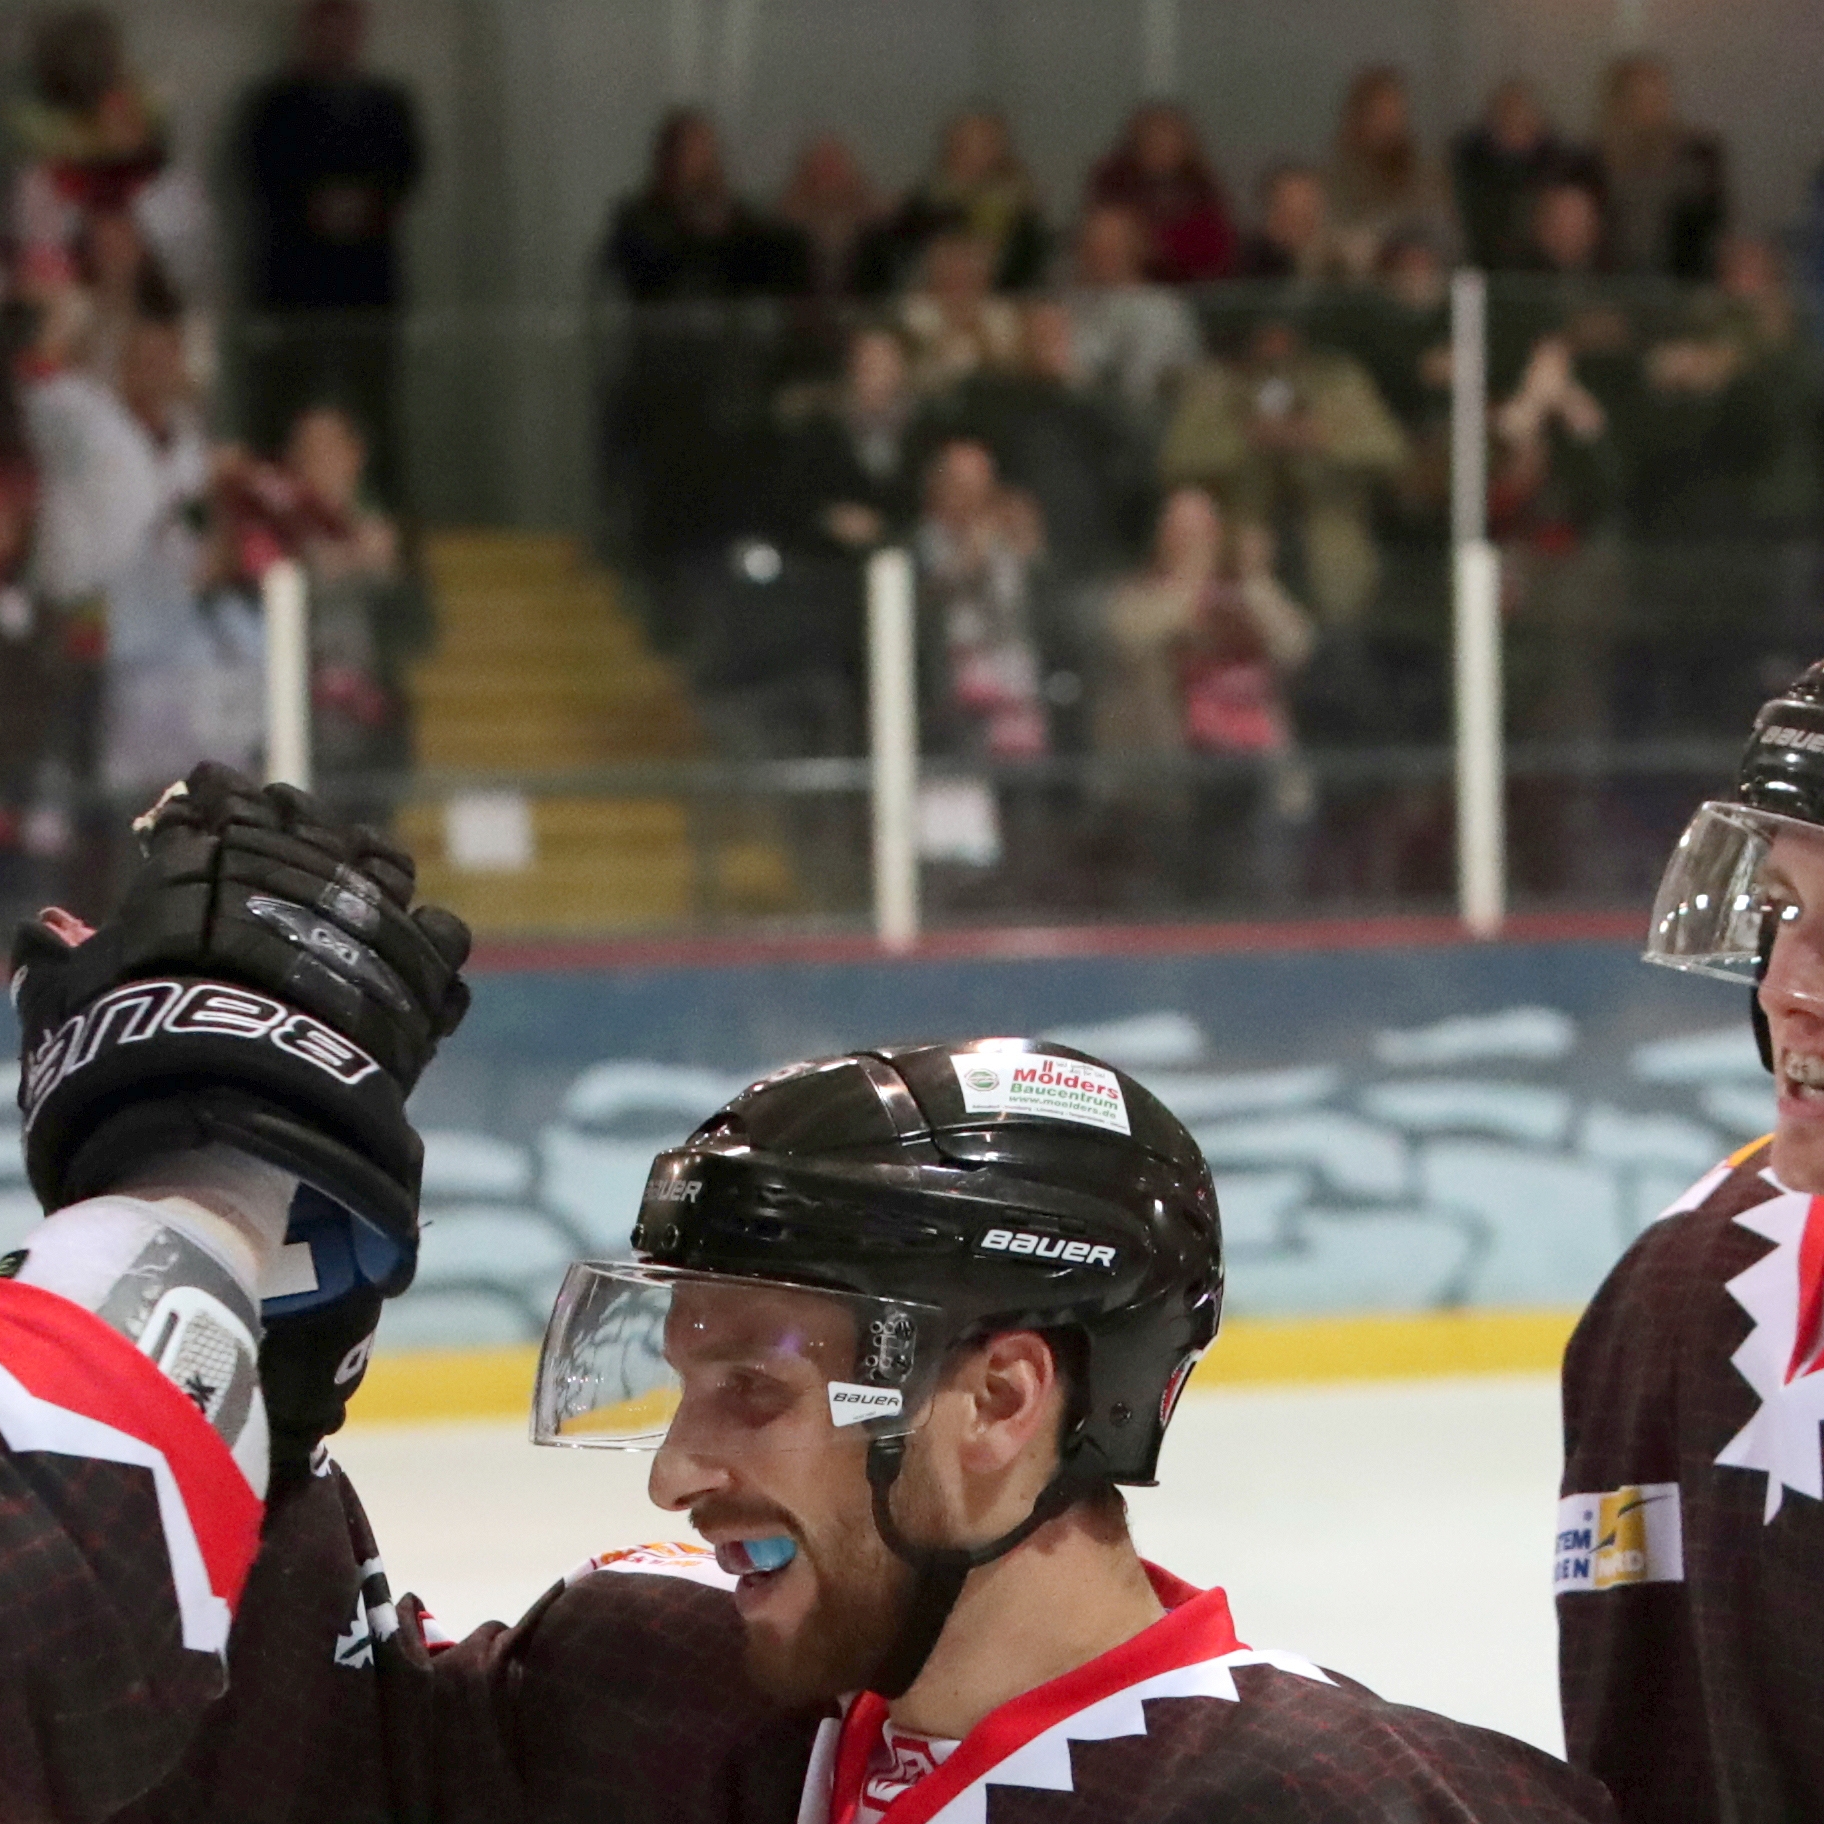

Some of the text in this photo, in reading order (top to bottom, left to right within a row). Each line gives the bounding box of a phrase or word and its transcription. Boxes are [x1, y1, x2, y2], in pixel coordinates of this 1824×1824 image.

[1010, 1084, 1119, 1111] Baucentrum
[979, 1228, 1117, 1268] BAUER
[833, 1392, 900, 1407] BAUER
